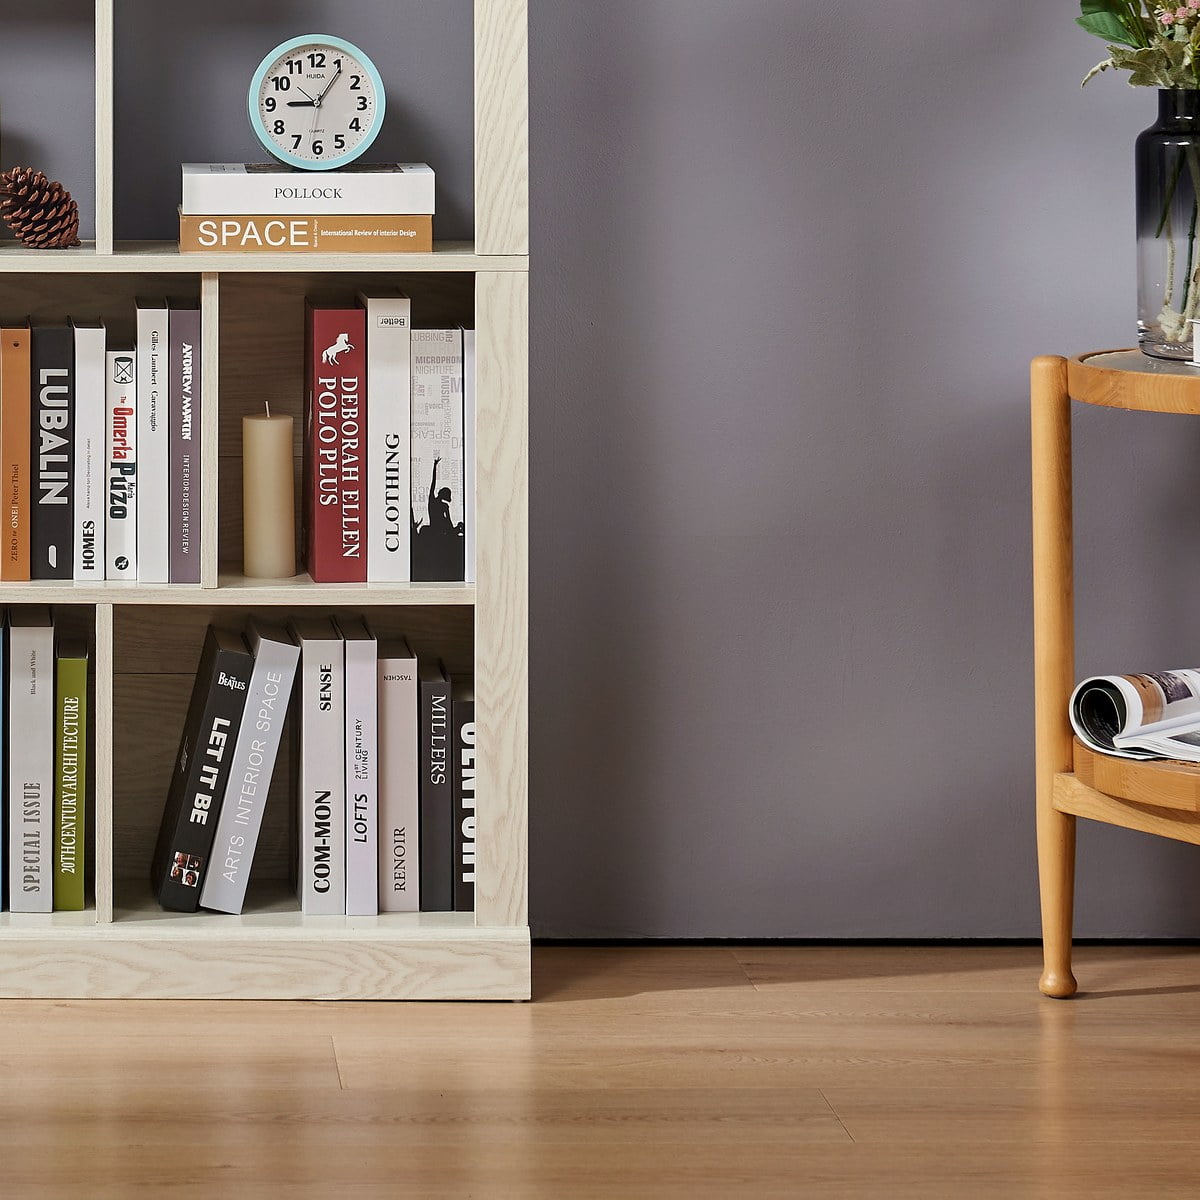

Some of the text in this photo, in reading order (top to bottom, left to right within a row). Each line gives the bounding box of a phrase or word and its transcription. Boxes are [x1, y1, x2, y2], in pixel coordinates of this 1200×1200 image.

[285, 59, 303, 74] 11
[307, 53, 326, 68] 12
[271, 76, 290, 91] 10
[349, 75, 361, 90] 2
[264, 96, 277, 112] 9
[356, 96, 368, 111] 3
[273, 120, 285, 135] 8
[349, 118, 361, 132] 4
[291, 134, 302, 150] 7
[312, 140, 323, 155] 6
[334, 134, 345, 149] 5
[274, 187, 343, 199] POLLOCK
[198, 220, 309, 247] SPACE
[320, 229, 353, 237] International
[354, 229, 372, 237] Review
[373, 229, 379, 237] of
[399, 229, 417, 238] Design
[380, 317, 405, 326] Better
[151, 331, 159, 351] Gilles
[415, 366, 454, 375] NIGHTLIFE
[181, 342, 193, 441] ANDREW MARTIN
[441, 376, 450, 404] MUSIC
[149, 390, 158, 432] Caravaggio
[38, 368, 69, 505] LUBALIN
[318, 376, 338, 506] POLO PLUS
[11, 464, 19, 483] Thiel
[341, 376, 360, 558] DEBORAH ELLEN
[11, 485, 19, 505] Peter
[109, 461, 136, 519] Puzo
[127, 482, 136, 499] Mario
[385, 432, 400, 552] CLOTHING
[10, 538, 18, 562] ZERO
[82, 520, 95, 570] HOMES
[217, 671, 246, 691] BEATLES
[431, 694, 446, 785] MILLERS
[189, 717, 231, 826] LET IT BE
[354, 764, 362, 780] 21ST
[361, 750, 369, 780] LIVING
[222, 670, 282, 883] ARTS INTERIOR SPACE
[313, 663, 332, 893] COM-MON SENSE
[354, 794, 368, 843] LOFTS
[23, 782, 40, 893] SPECIAL ISSUE
[393, 827, 406, 892] RENOIR
